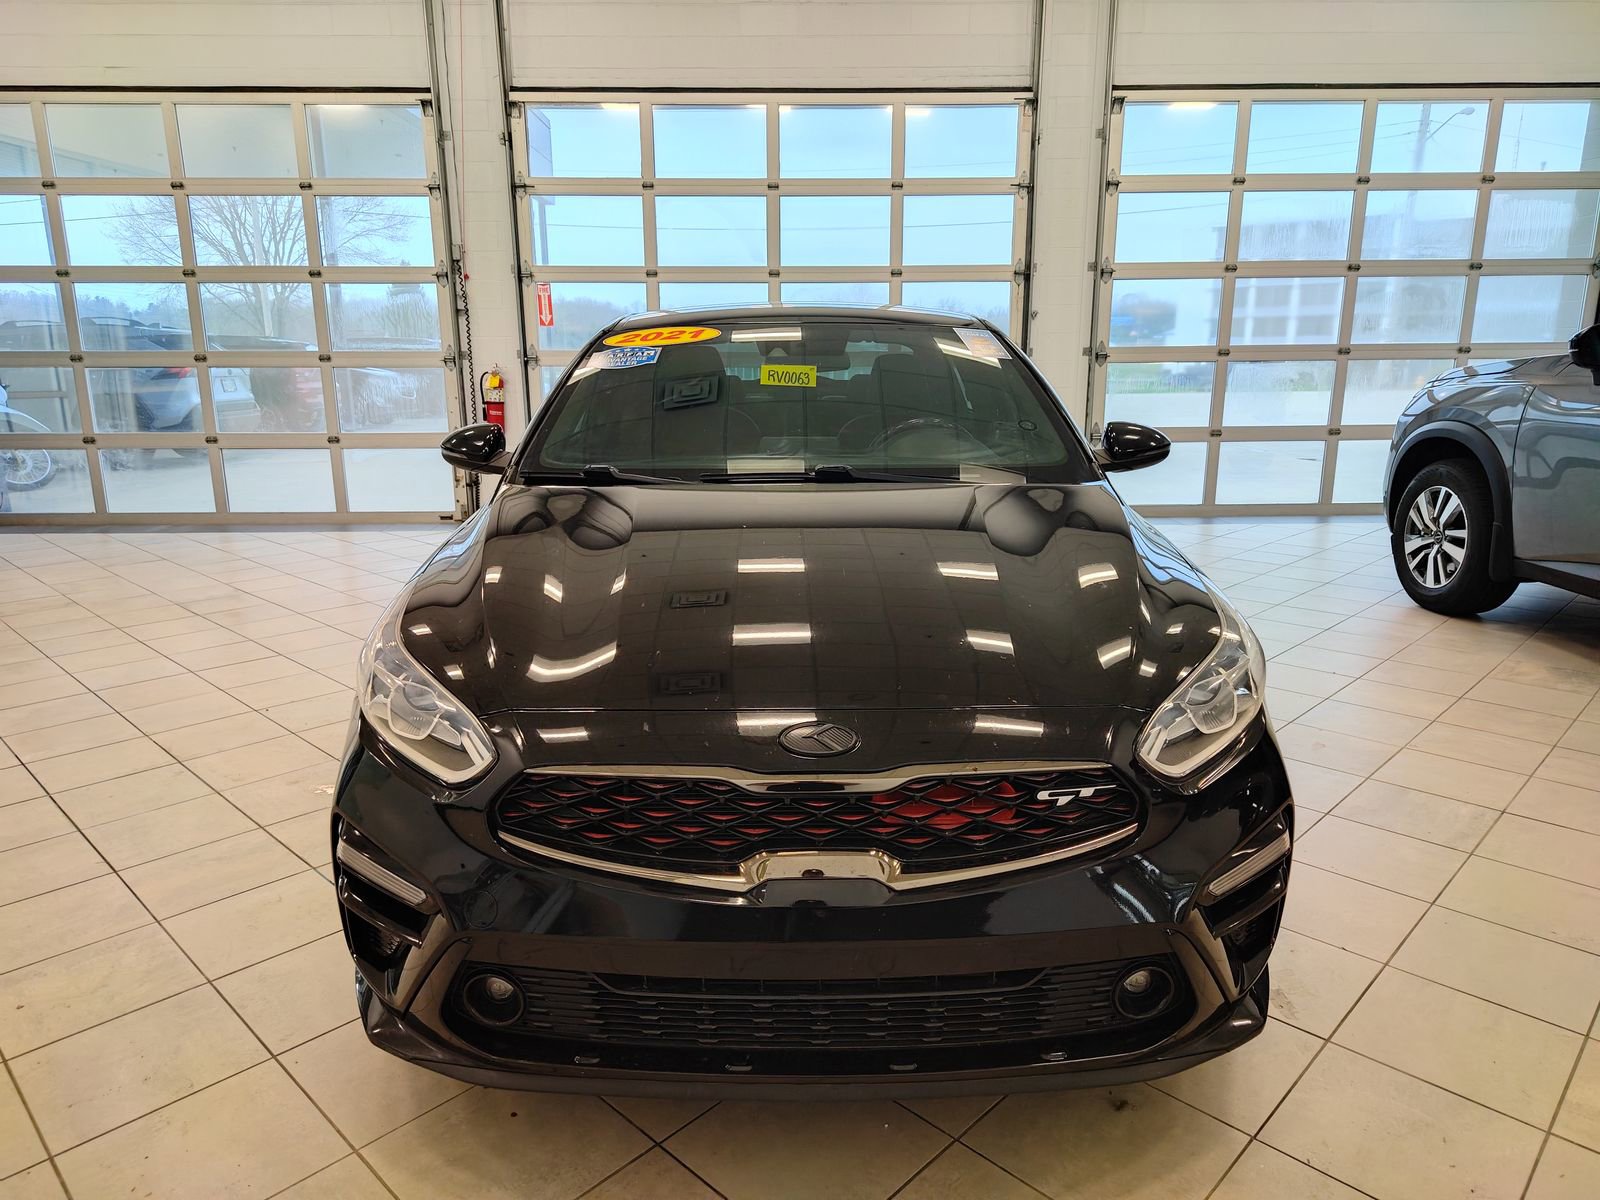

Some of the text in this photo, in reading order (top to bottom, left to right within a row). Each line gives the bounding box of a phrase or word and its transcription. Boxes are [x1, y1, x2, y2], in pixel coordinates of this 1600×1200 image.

[615, 329, 705, 344] 2021
[767, 369, 811, 385] RV0063
[1036, 784, 1117, 807] GT
